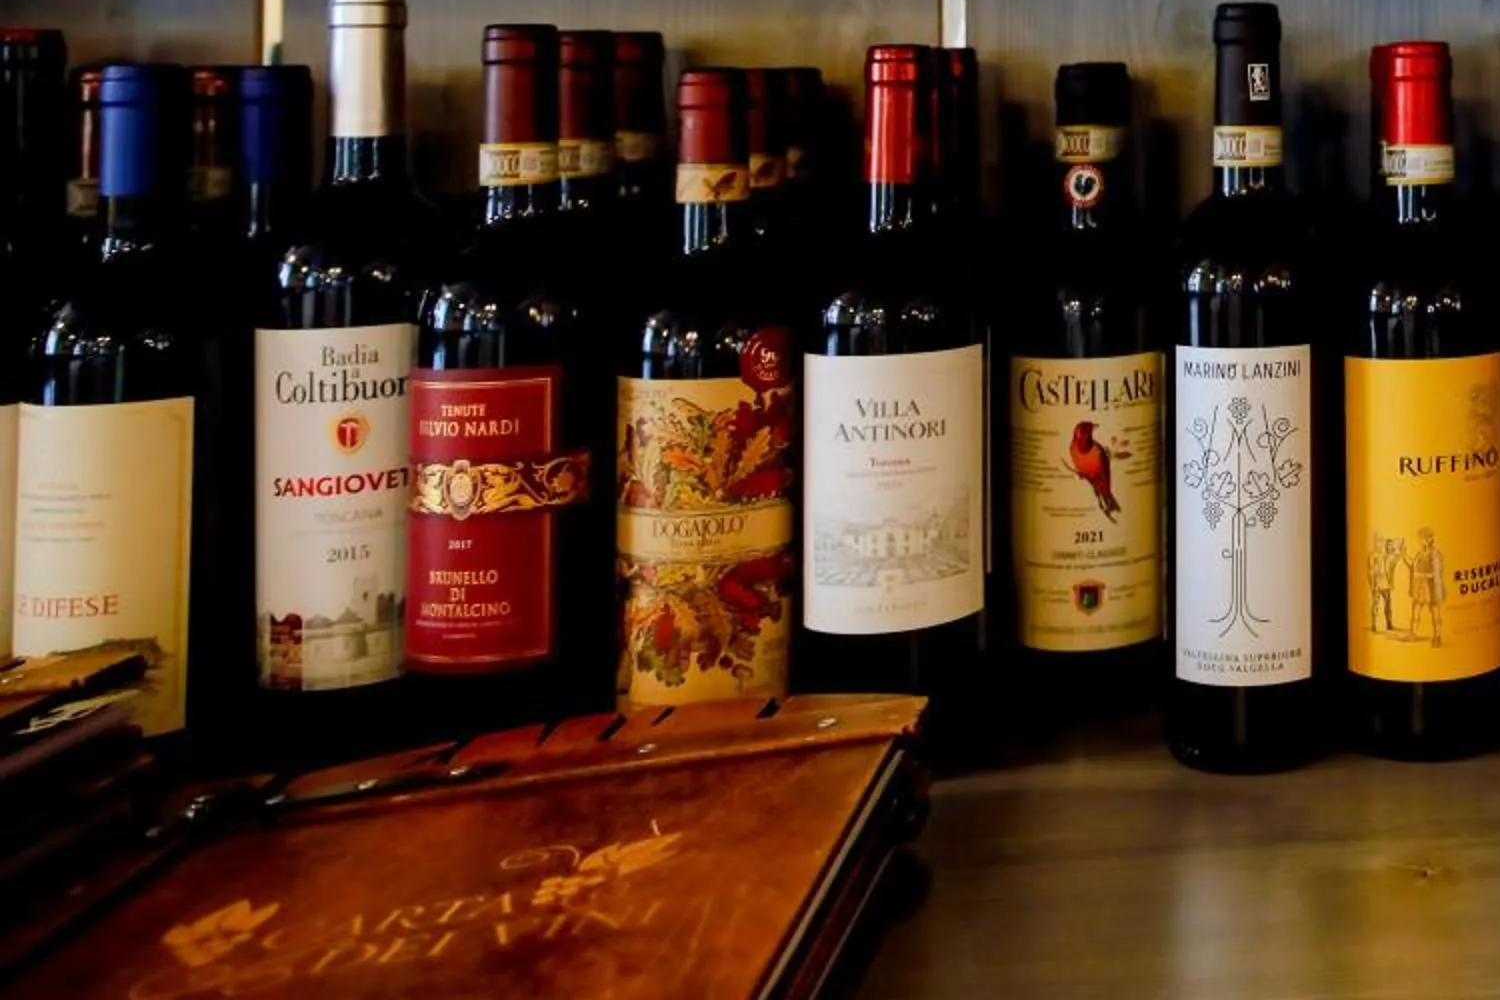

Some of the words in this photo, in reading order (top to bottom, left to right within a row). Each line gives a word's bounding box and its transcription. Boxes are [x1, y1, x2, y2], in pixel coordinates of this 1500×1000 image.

[321, 343, 380, 367] Badia
[1183, 359, 1238, 380] MARINO
[1241, 359, 1301, 380] LANZINI
[440, 403, 487, 417] TENUTE
[855, 397, 921, 420] VILLA
[463, 418, 520, 437] NARDI
[834, 419, 947, 444] ANTINORI
[1399, 446, 1500, 478] RUFFINO
[325, 544, 371, 563] 2015
[429, 569, 499, 586] BRUNELLO
[450, 587, 465, 601] DI
[31, 594, 119, 619] DIFESE
[420, 601, 511, 618] MONTALCINO
